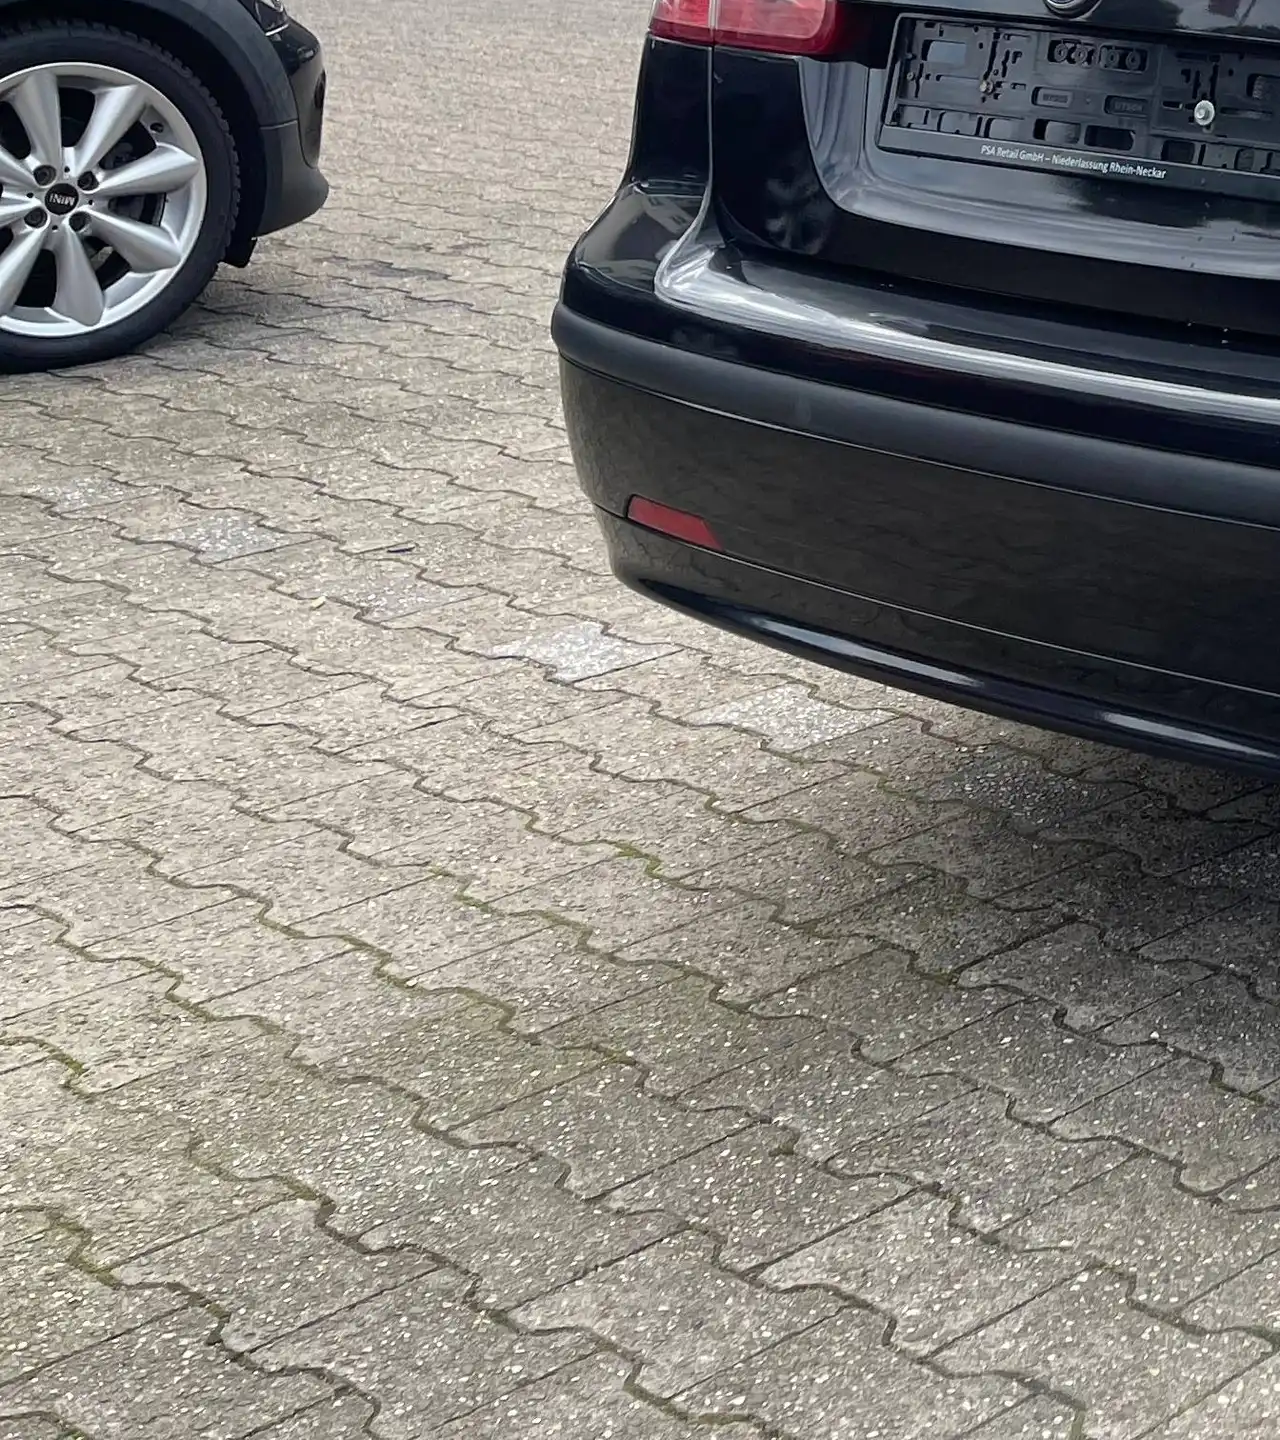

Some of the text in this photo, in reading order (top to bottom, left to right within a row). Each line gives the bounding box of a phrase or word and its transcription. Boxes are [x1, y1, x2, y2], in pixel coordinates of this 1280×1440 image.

[980, 144, 996, 156] PSA
[996, 146, 1020, 159] Retail
[1019, 150, 1044, 163] GmbH
[1051, 154, 1109, 173] Niederlassung
[1109, 161, 1167, 179] Rhein-Neckar
[50, 192, 75, 207] MINI
